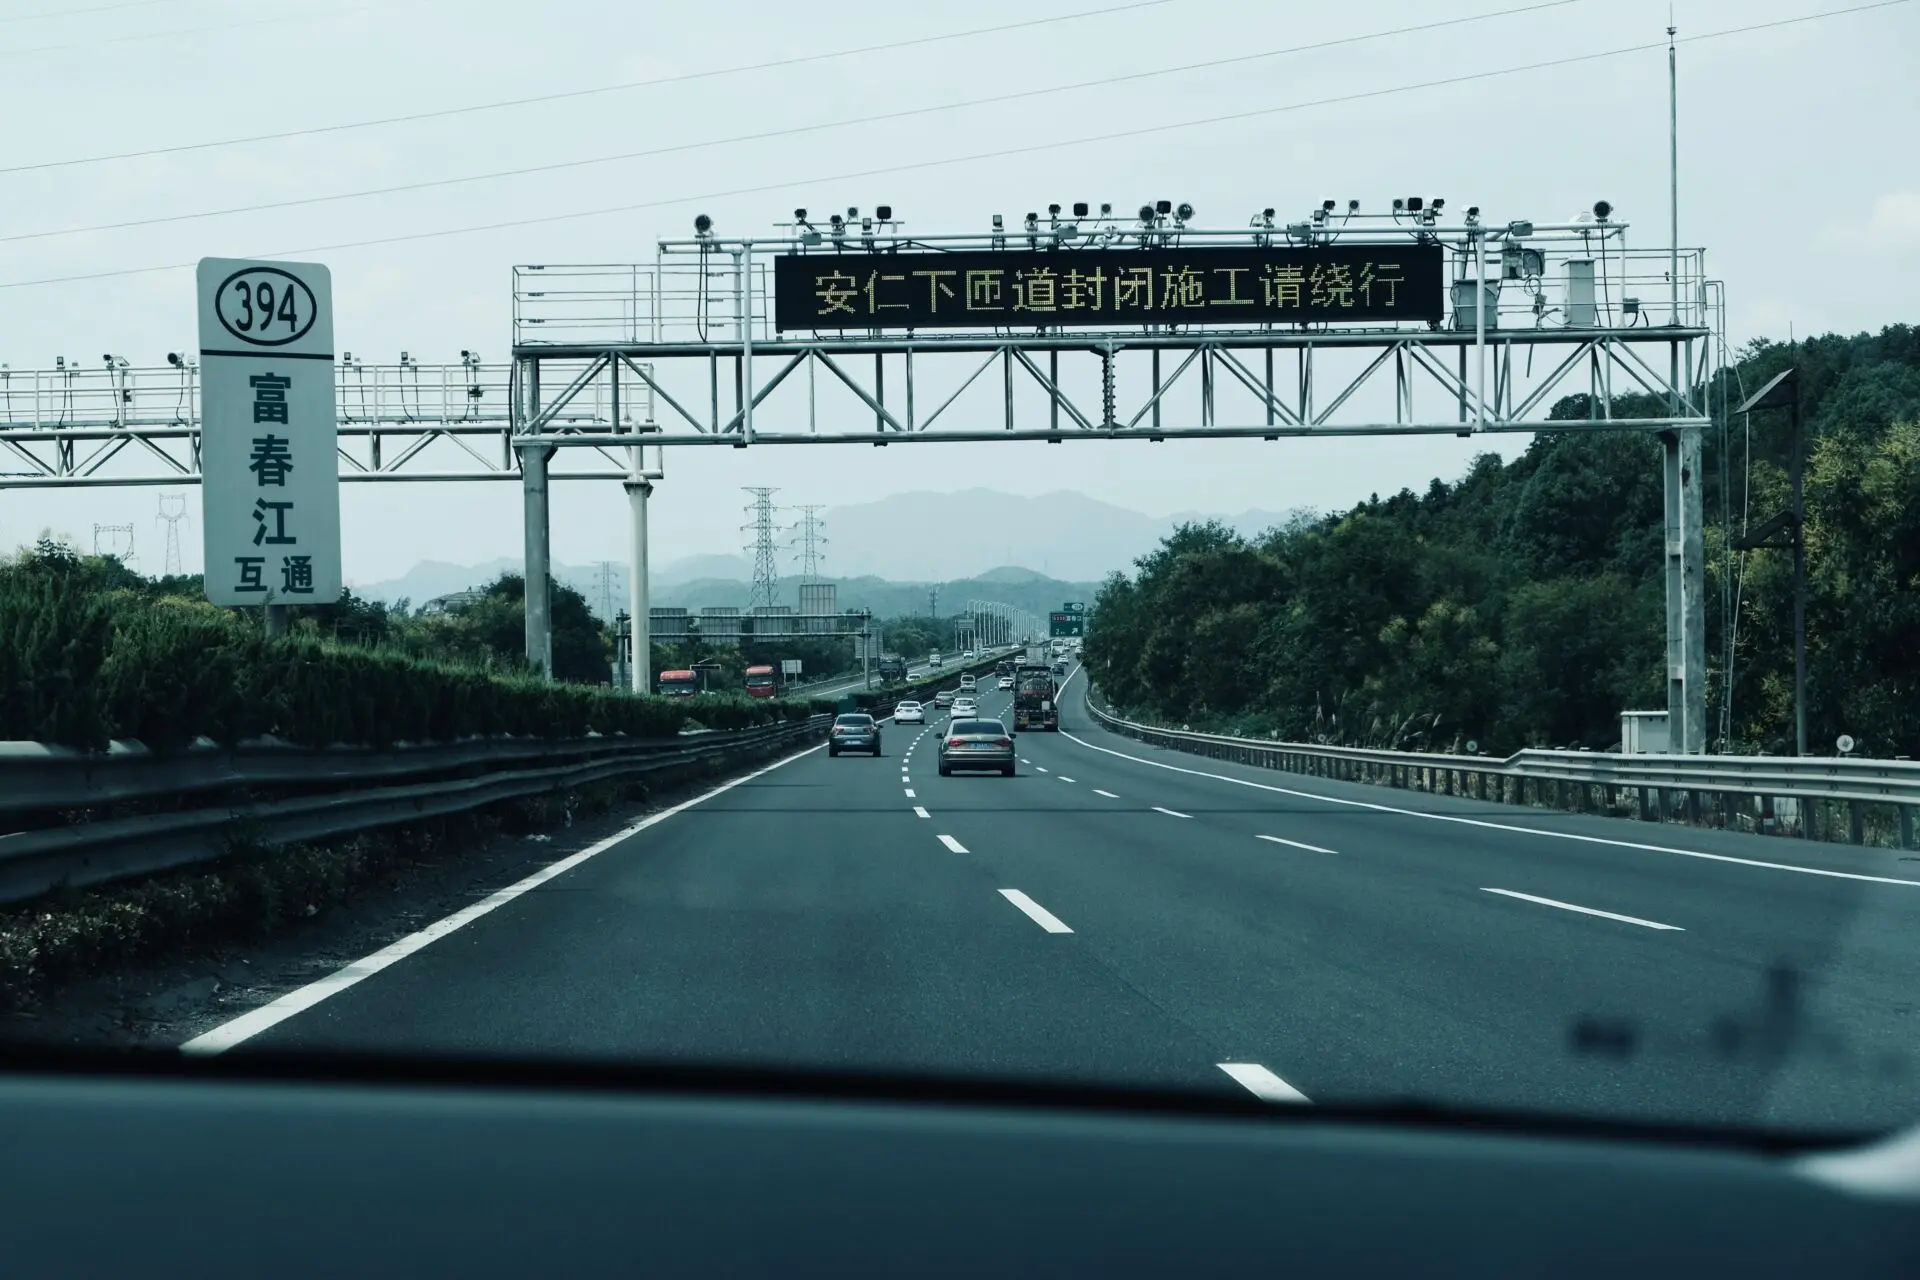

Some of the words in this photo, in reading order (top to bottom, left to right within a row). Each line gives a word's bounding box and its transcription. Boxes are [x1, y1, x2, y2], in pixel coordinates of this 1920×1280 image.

[235, 280, 298, 333] 394
[815, 262, 1405, 314] 安仁下匝道封闭施工请绕行
[249, 372, 297, 547] 富春江
[234, 555, 315, 594] 互通
